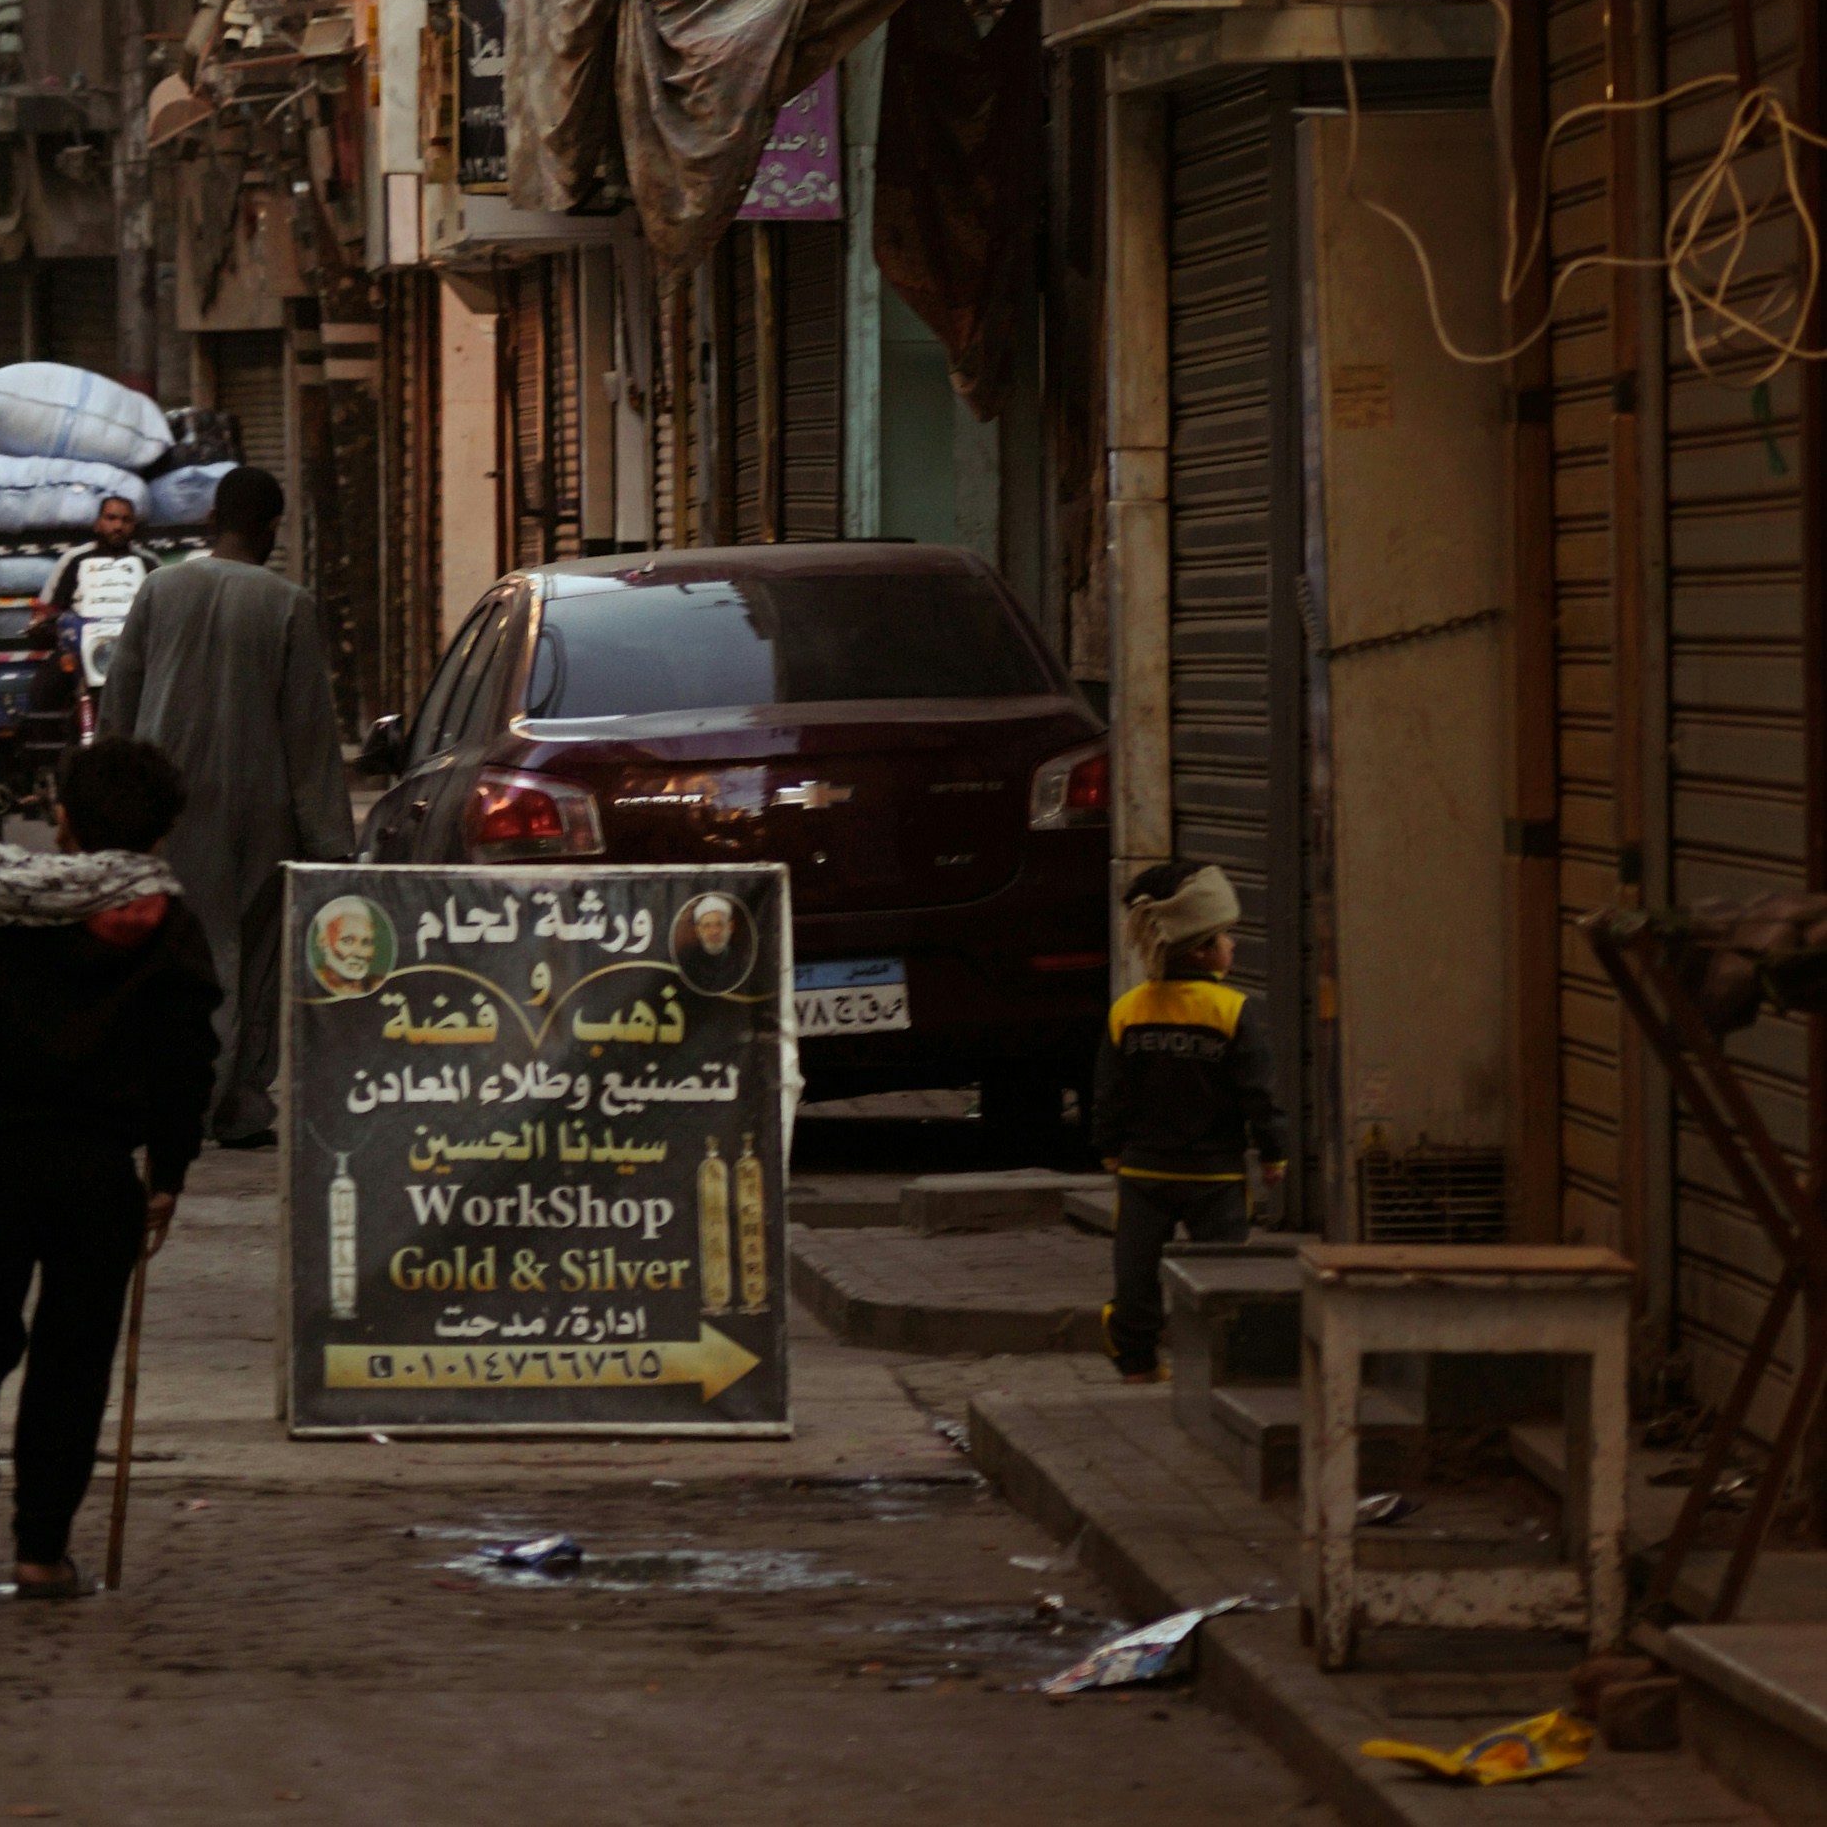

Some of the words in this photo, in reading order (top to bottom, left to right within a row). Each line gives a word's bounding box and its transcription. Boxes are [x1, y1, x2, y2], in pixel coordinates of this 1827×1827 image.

[417, 893, 520, 959] لحام
[533, 887, 653, 953] ورشة
[523, 959, 552, 1007] و
[379, 987, 500, 1046] فضة
[572, 984, 685, 1058] ذهب
[347, 1064, 471, 1114] المعادن
[478, 1062, 592, 1110] وطلاء
[599, 1064, 740, 1115] لتصنيع
[408, 1120, 547, 1174] الحسين
[557, 1123, 669, 1175] سيدنا
[406, 1184, 674, 1240] WorkShop
[389, 1245, 497, 1291] Gold
[509, 1248, 548, 1291] &
[559, 1246, 690, 1291] Silver
[433, 1304, 546, 1339] مدحت
